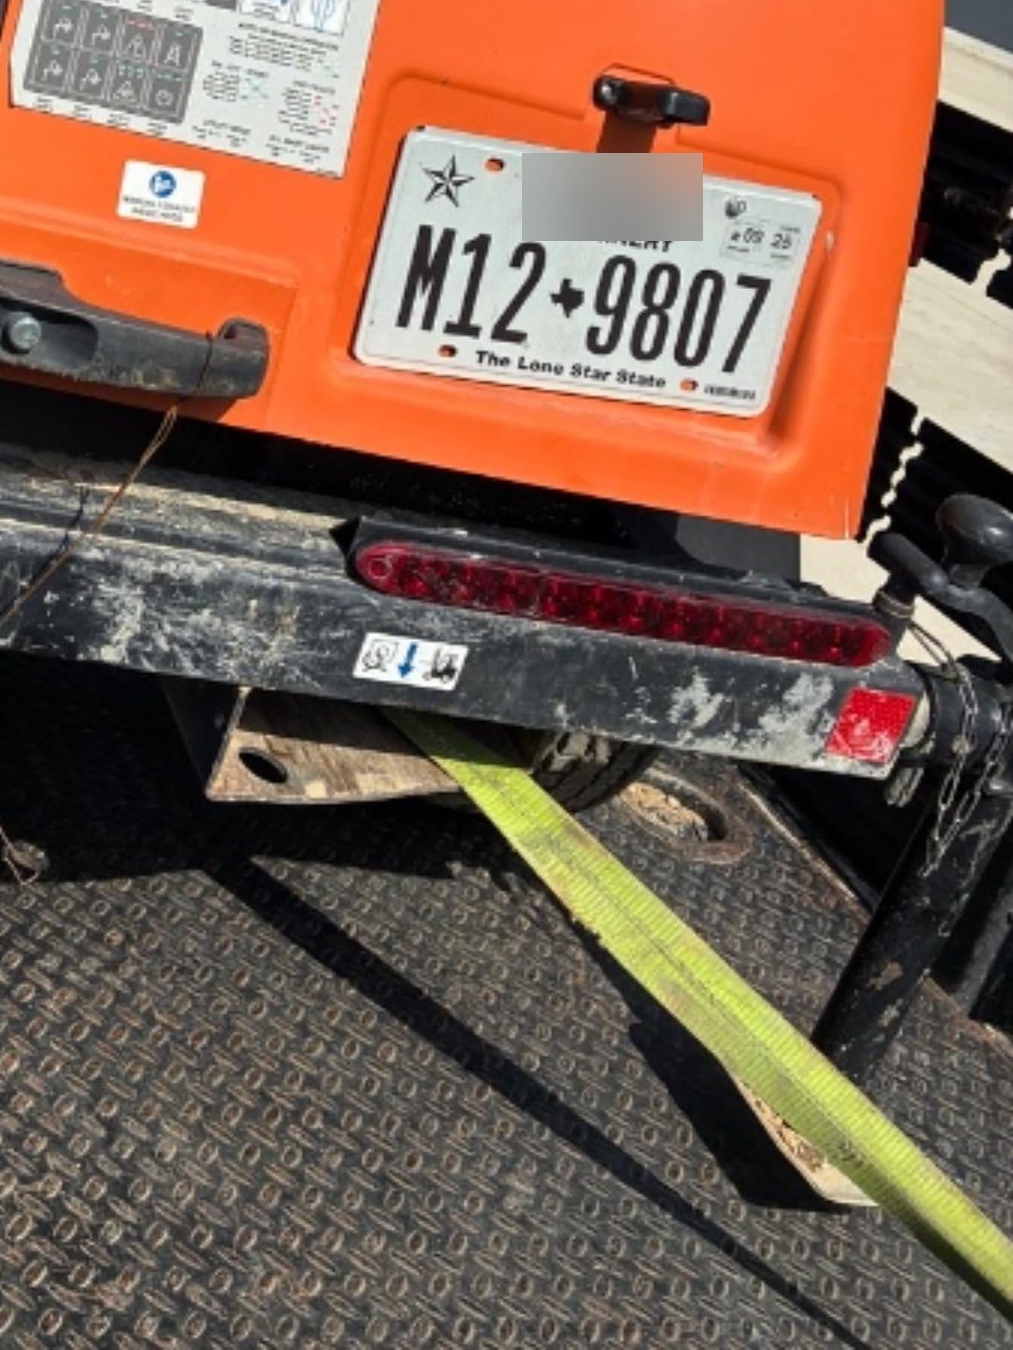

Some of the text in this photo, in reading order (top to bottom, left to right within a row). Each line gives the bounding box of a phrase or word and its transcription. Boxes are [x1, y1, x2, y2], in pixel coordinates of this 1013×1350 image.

[397, 225, 771, 373] M12 9807
[476, 350, 666, 388] The Lone Star State
